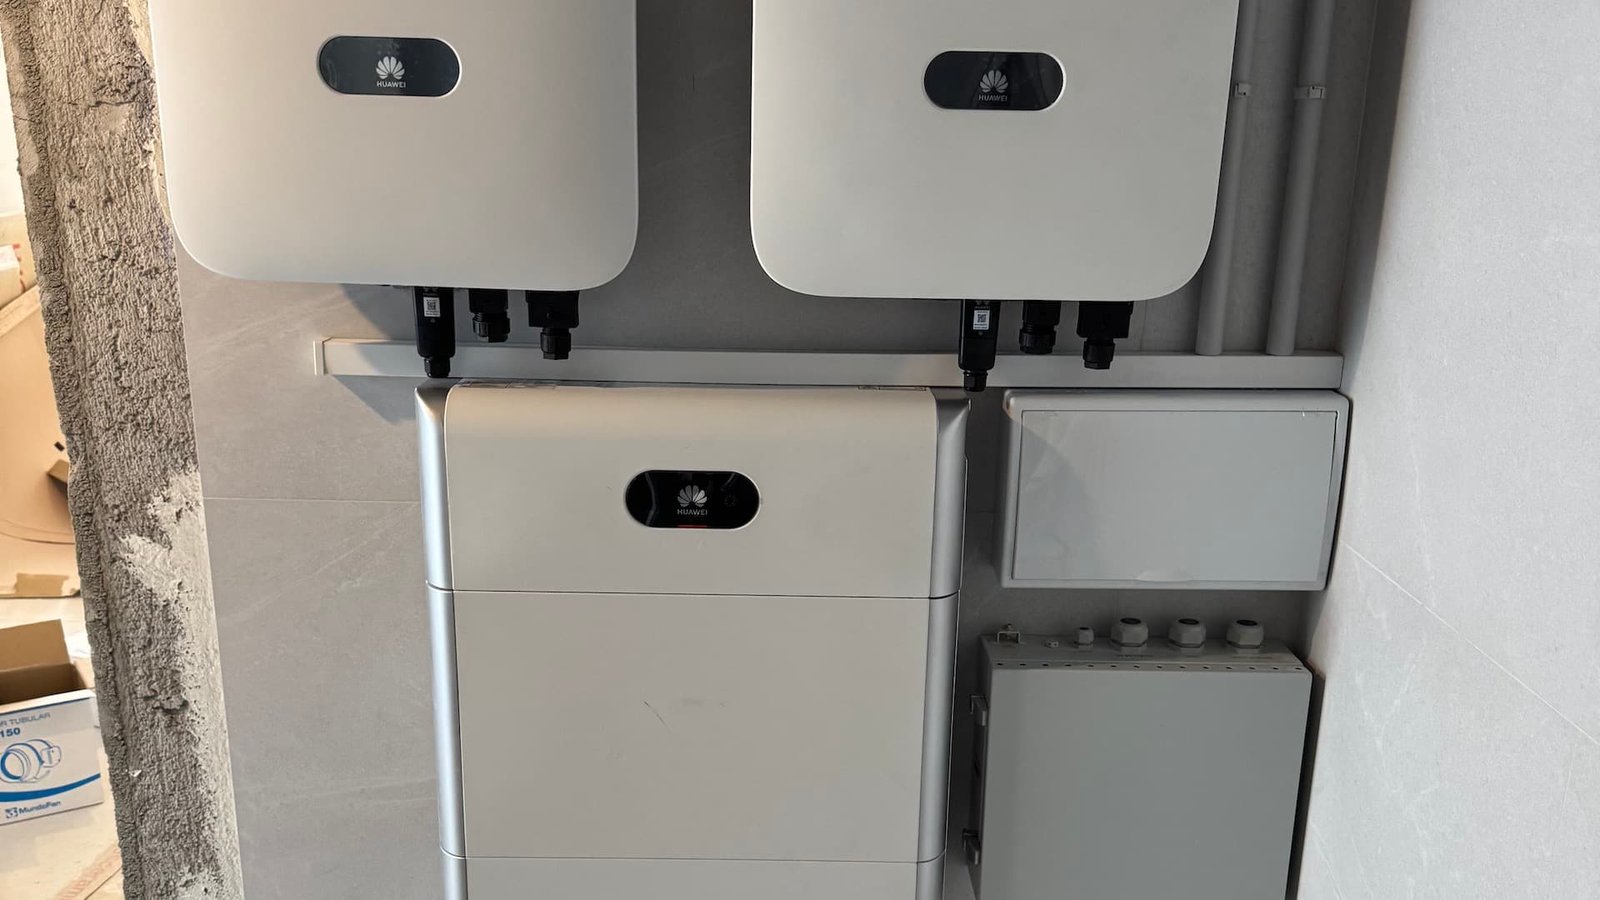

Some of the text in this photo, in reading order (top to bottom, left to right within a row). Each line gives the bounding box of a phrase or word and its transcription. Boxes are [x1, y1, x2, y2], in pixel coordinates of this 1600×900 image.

[979, 94, 1008, 102] HUAWEI
[9, 712, 51, 724] TUBULAR
[18, 801, 61, 814] MundoFan
